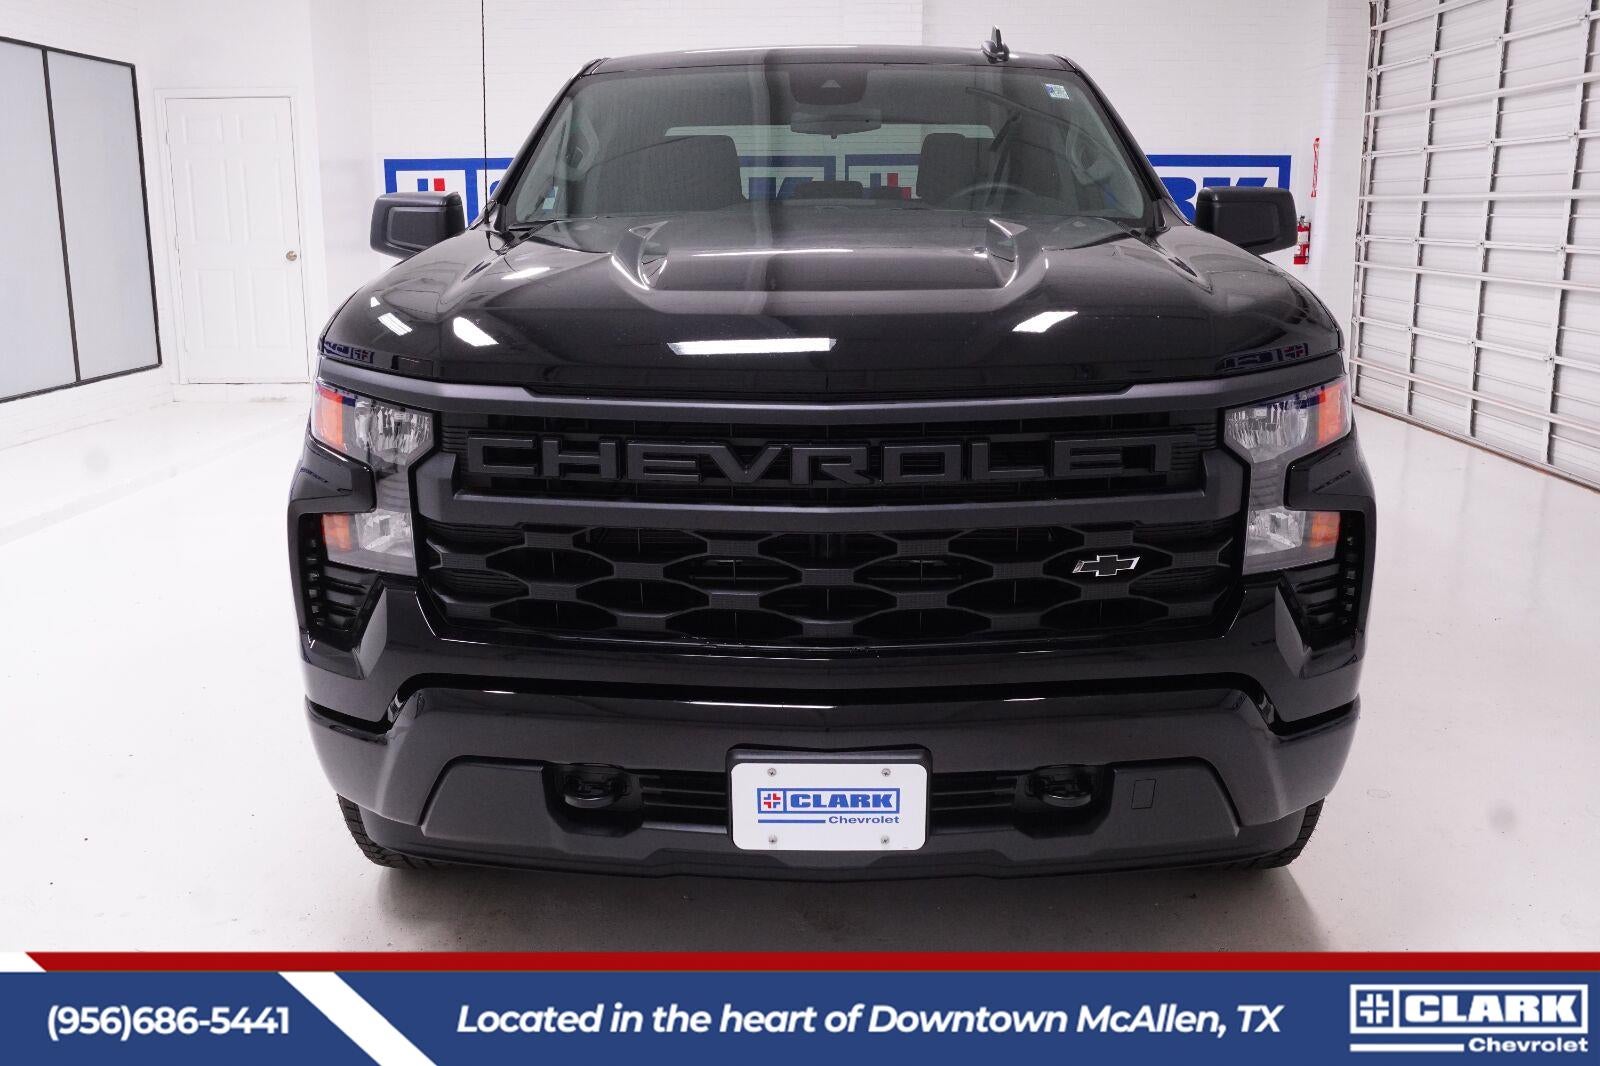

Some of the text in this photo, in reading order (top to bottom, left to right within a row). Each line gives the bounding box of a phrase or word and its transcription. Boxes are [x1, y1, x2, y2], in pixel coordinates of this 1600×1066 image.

[467, 434, 1198, 485] CHEVROLET
[790, 793, 893, 808] CLARK
[828, 815, 900, 824] Chevrolet
